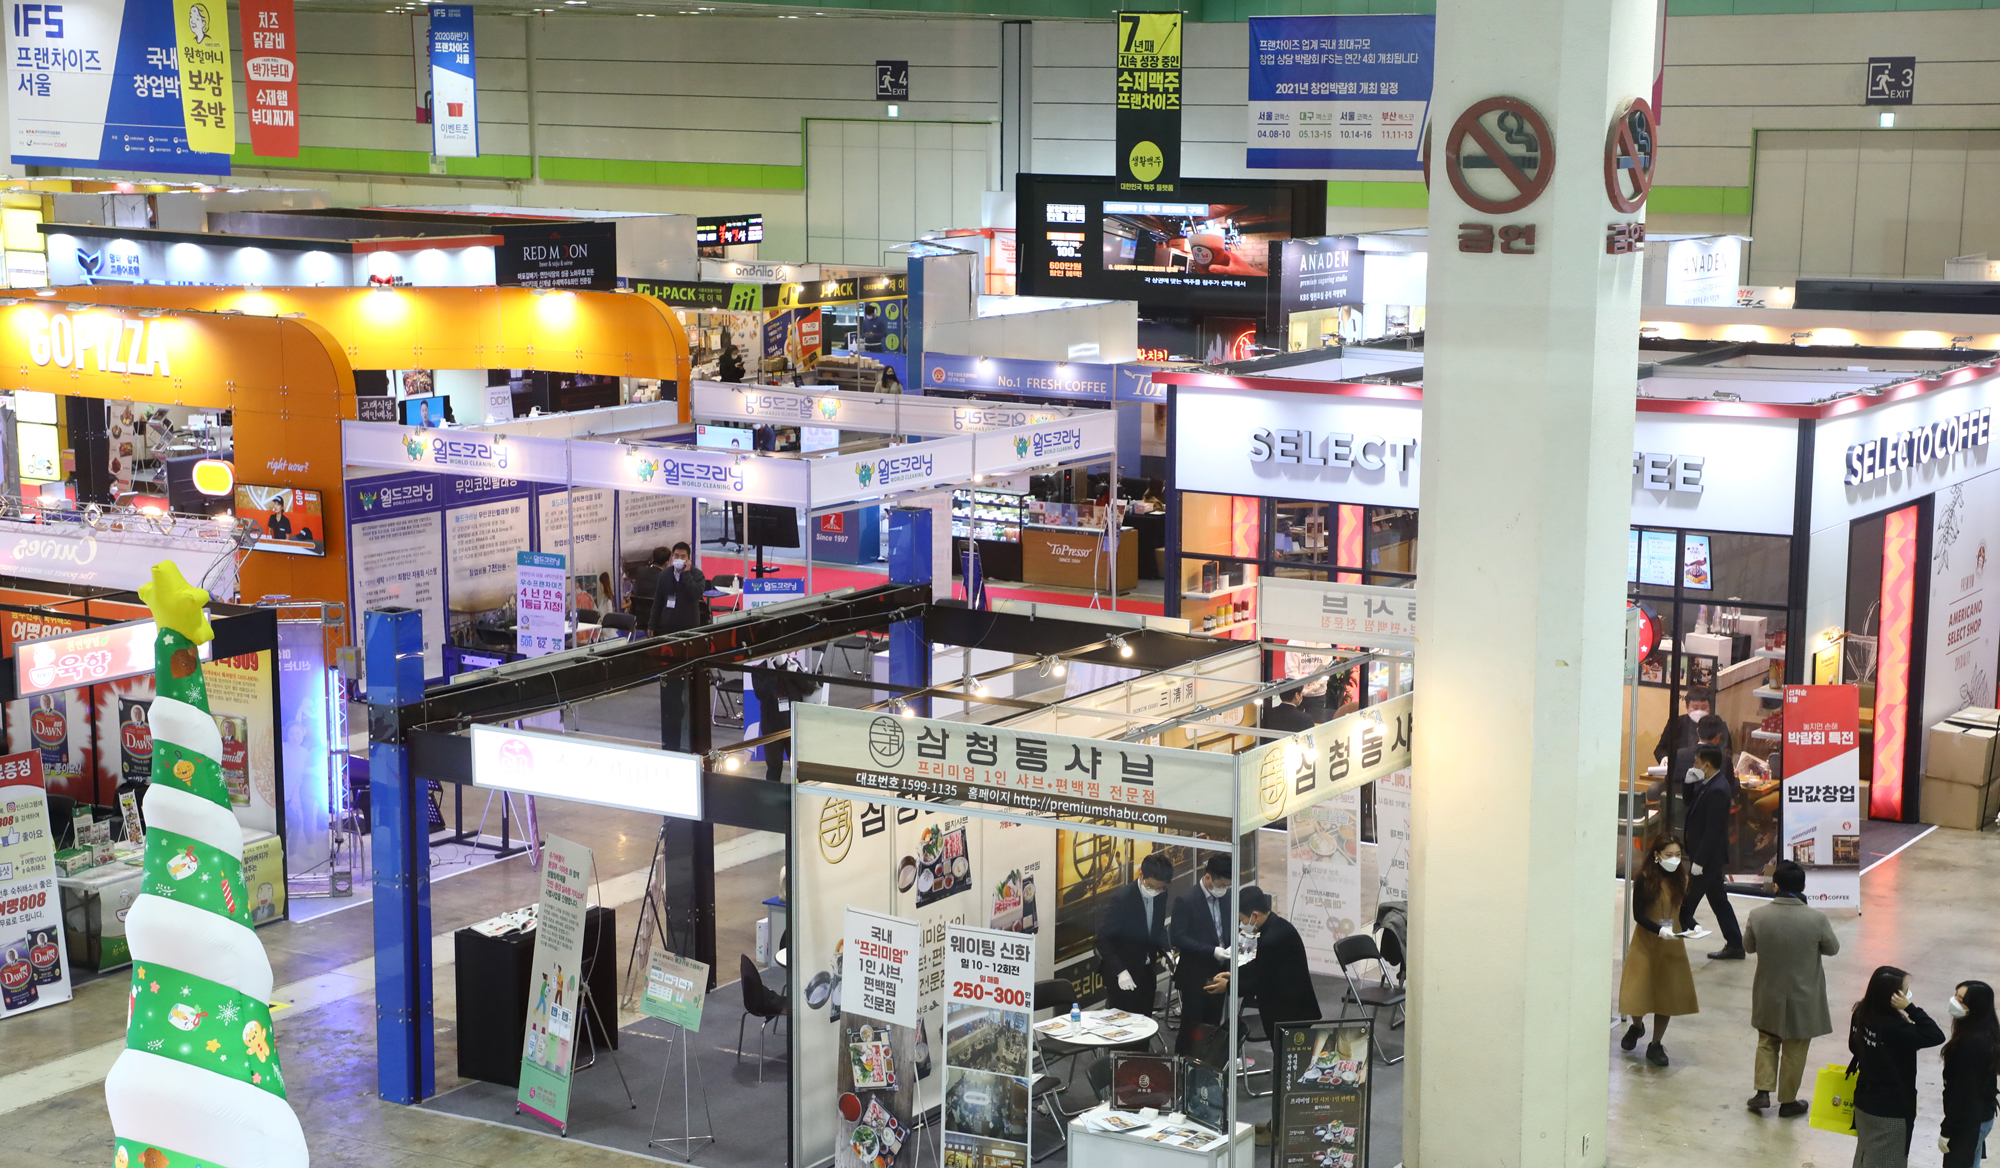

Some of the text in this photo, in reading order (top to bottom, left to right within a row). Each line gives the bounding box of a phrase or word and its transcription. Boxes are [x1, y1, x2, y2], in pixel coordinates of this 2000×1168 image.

[14, 3, 64, 39] IFS
[258, 11, 280, 29] 치즈
[433, 9, 446, 18] IFS
[252, 32, 286, 50] 닭갈비
[434, 32, 470, 42] 2020하반기
[1259, 38, 1371, 51] 프랜차이즈 업계 국내 최대규모
[183, 46, 224, 65] 원할머니
[434, 42, 470, 53] 프랜차이즈
[17, 47, 102, 72] 프랜차이즈
[146, 47, 179, 70] 국내
[455, 54, 470, 65] 서울
[1119, 55, 1180, 68] 지속 성장 중인
[1259, 52, 1419, 65] 창업 상담 박람회 IFS는 연간 4회 개최됩니다
[251, 62, 291, 79] 박가부대
[898, 70, 908, 86] 4
[1901, 68, 1914, 87] 3
[18, 73, 52, 97] 서울
[188, 70, 223, 97] 보쌈
[1118, 71, 1180, 92] 수제맥주
[1275, 82, 1399, 95] 2021년 창업박람회 개최 일정
[256, 90, 289, 107] 수제햄
[892, 88, 907, 96] EXIT
[1890, 89, 1911, 99] EXIT
[1117, 92, 1180, 110] 프랜차이즈
[190, 100, 226, 129] 족발
[251, 109, 294, 127] 부대찌개
[1257, 111, 1273, 121] 서울
[1299, 111, 1315, 121] 대구
[1339, 111, 1355, 121] 서울
[1381, 111, 1397, 121] 부산
[440, 123, 470, 135] 이벤트존
[1257, 130, 1291, 139] 04.08-10
[1298, 130, 1332, 139] 05.13-15
[1340, 130, 1373, 139] 10.14-16
[1381, 130, 1414, 139] 11.11-13
[1130, 155, 1162, 168] 생활맥주
[1120, 183, 1143, 192] 대한민국
[1457, 222, 1537, 255] 금연
[1606, 222, 1646, 255] 금연
[522, 245, 547, 261] RED
[1299, 249, 1350, 272] ANADEN
[538, 260, 548, 268] beer
[652, 286, 697, 301] J-PACK
[819, 282, 854, 298] J-PACK
[28, 313, 171, 378] GOPIZZA
[997, 375, 1107, 394] No.1 FRESH COFFEE
[361, 399, 394, 410] 고래식당
[490, 395, 511, 406] DDM
[1032, 427, 1081, 457] 월드크리닝
[1043, 445, 1074, 455] WORLD CLEANING
[432, 437, 509, 469] 월드크리닝
[266, 457, 310, 474] right now?
[449, 458, 496, 468] WORLD CLEANING
[878, 453, 933, 485] 월드크리닝
[663, 458, 744, 491] 월드크리닝
[890, 471, 925, 483] WORLD CLEANING
[681, 480, 731, 490] WORLD CLEANING
[380, 483, 434, 509] 월드크리닝
[816, 533, 849, 543] Since 1997
[1046, 541, 1093, 558] ToPresso
[520, 578, 563, 590] 우수프랜차이즈
[763, 581, 797, 592] 월드크리닝
[520, 598, 563, 613] 1등급 지정!
[1947, 599, 1984, 628] AMERICANO
[1947, 617, 1982, 647] SELECT SHOP
[520, 638, 533, 648] 500
[537, 639, 546, 649] 62
[552, 641, 561, 651] 25
[56, 650, 112, 681] 육향
[1788, 688, 1807, 697] 선착순
[34, 718, 63, 737] DAWN
[1787, 731, 1854, 746] 박람회 특전
[916, 724, 1155, 787] 삼청동샤브
[916, 760, 1156, 806] 프리미엄 1인 전문점
[856, 772, 1168, 826] 대표번호 1599-1135 홈페이지 http://premiumshabu.com
[1787, 785, 1856, 803] 반값창업
[944, 815, 970, 831] 멸치샤브
[22, 829, 44, 843] 좋아요
[39, 879, 53, 890] 좋은
[19, 910, 45, 922] 드립니다.
[870, 925, 893, 945] 국내
[854, 939, 909, 965] “프리미엄”
[949, 934, 1031, 963] 웨이팅 신화
[34, 951, 56, 964] DAWN
[858, 957, 904, 984] 1인 샤브,
[960, 957, 1020, 977] 일 10 12회전
[4, 969, 29, 985] DAWN
[979, 974, 1000, 985] 일 매출
[863, 976, 897, 998] 편백찜
[952, 980, 1026, 1007] 250-300
[863, 993, 896, 1016] 전문점
[1024, 999, 1031, 1008] 원
